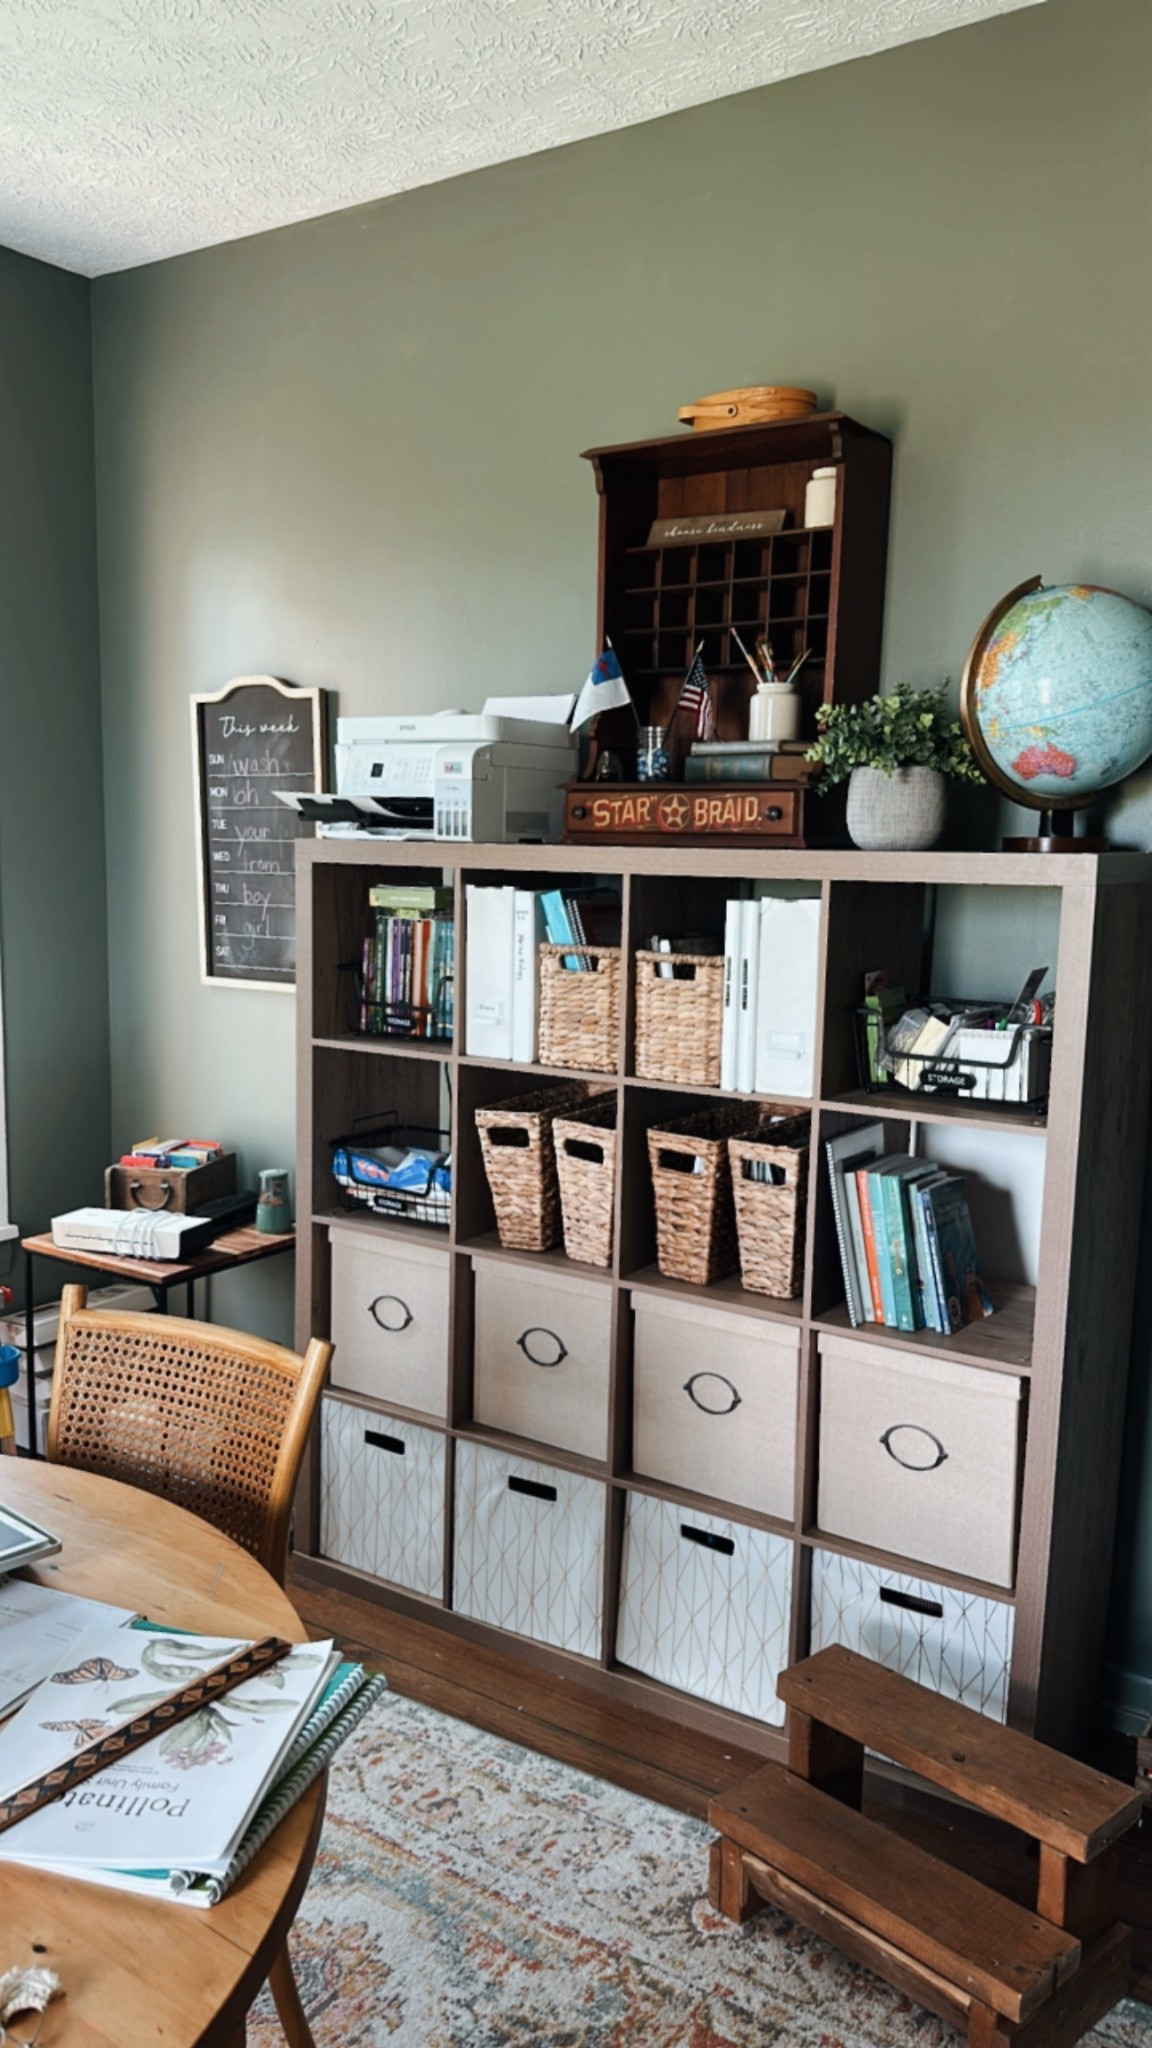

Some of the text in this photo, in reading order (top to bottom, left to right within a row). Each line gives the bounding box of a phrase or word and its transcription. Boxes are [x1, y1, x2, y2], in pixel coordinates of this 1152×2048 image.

[664, 521, 765, 537] choose kindness
[219, 714, 299, 738] This week
[208, 753, 224, 765] SUN
[232, 749, 279, 777] wash
[209, 786, 228, 798] MON
[694, 796, 763, 827] BRAID.
[212, 819, 227, 830] TUE
[213, 850, 231, 862] WED
[214, 882, 230, 894] THU
[215, 914, 227, 926] FRI
[215, 945, 231, 957] SAT
[927, 1072, 966, 1087] STORAGE
[95, 1776, 128, 1789] Unit
[130, 1777, 180, 1793] Family
